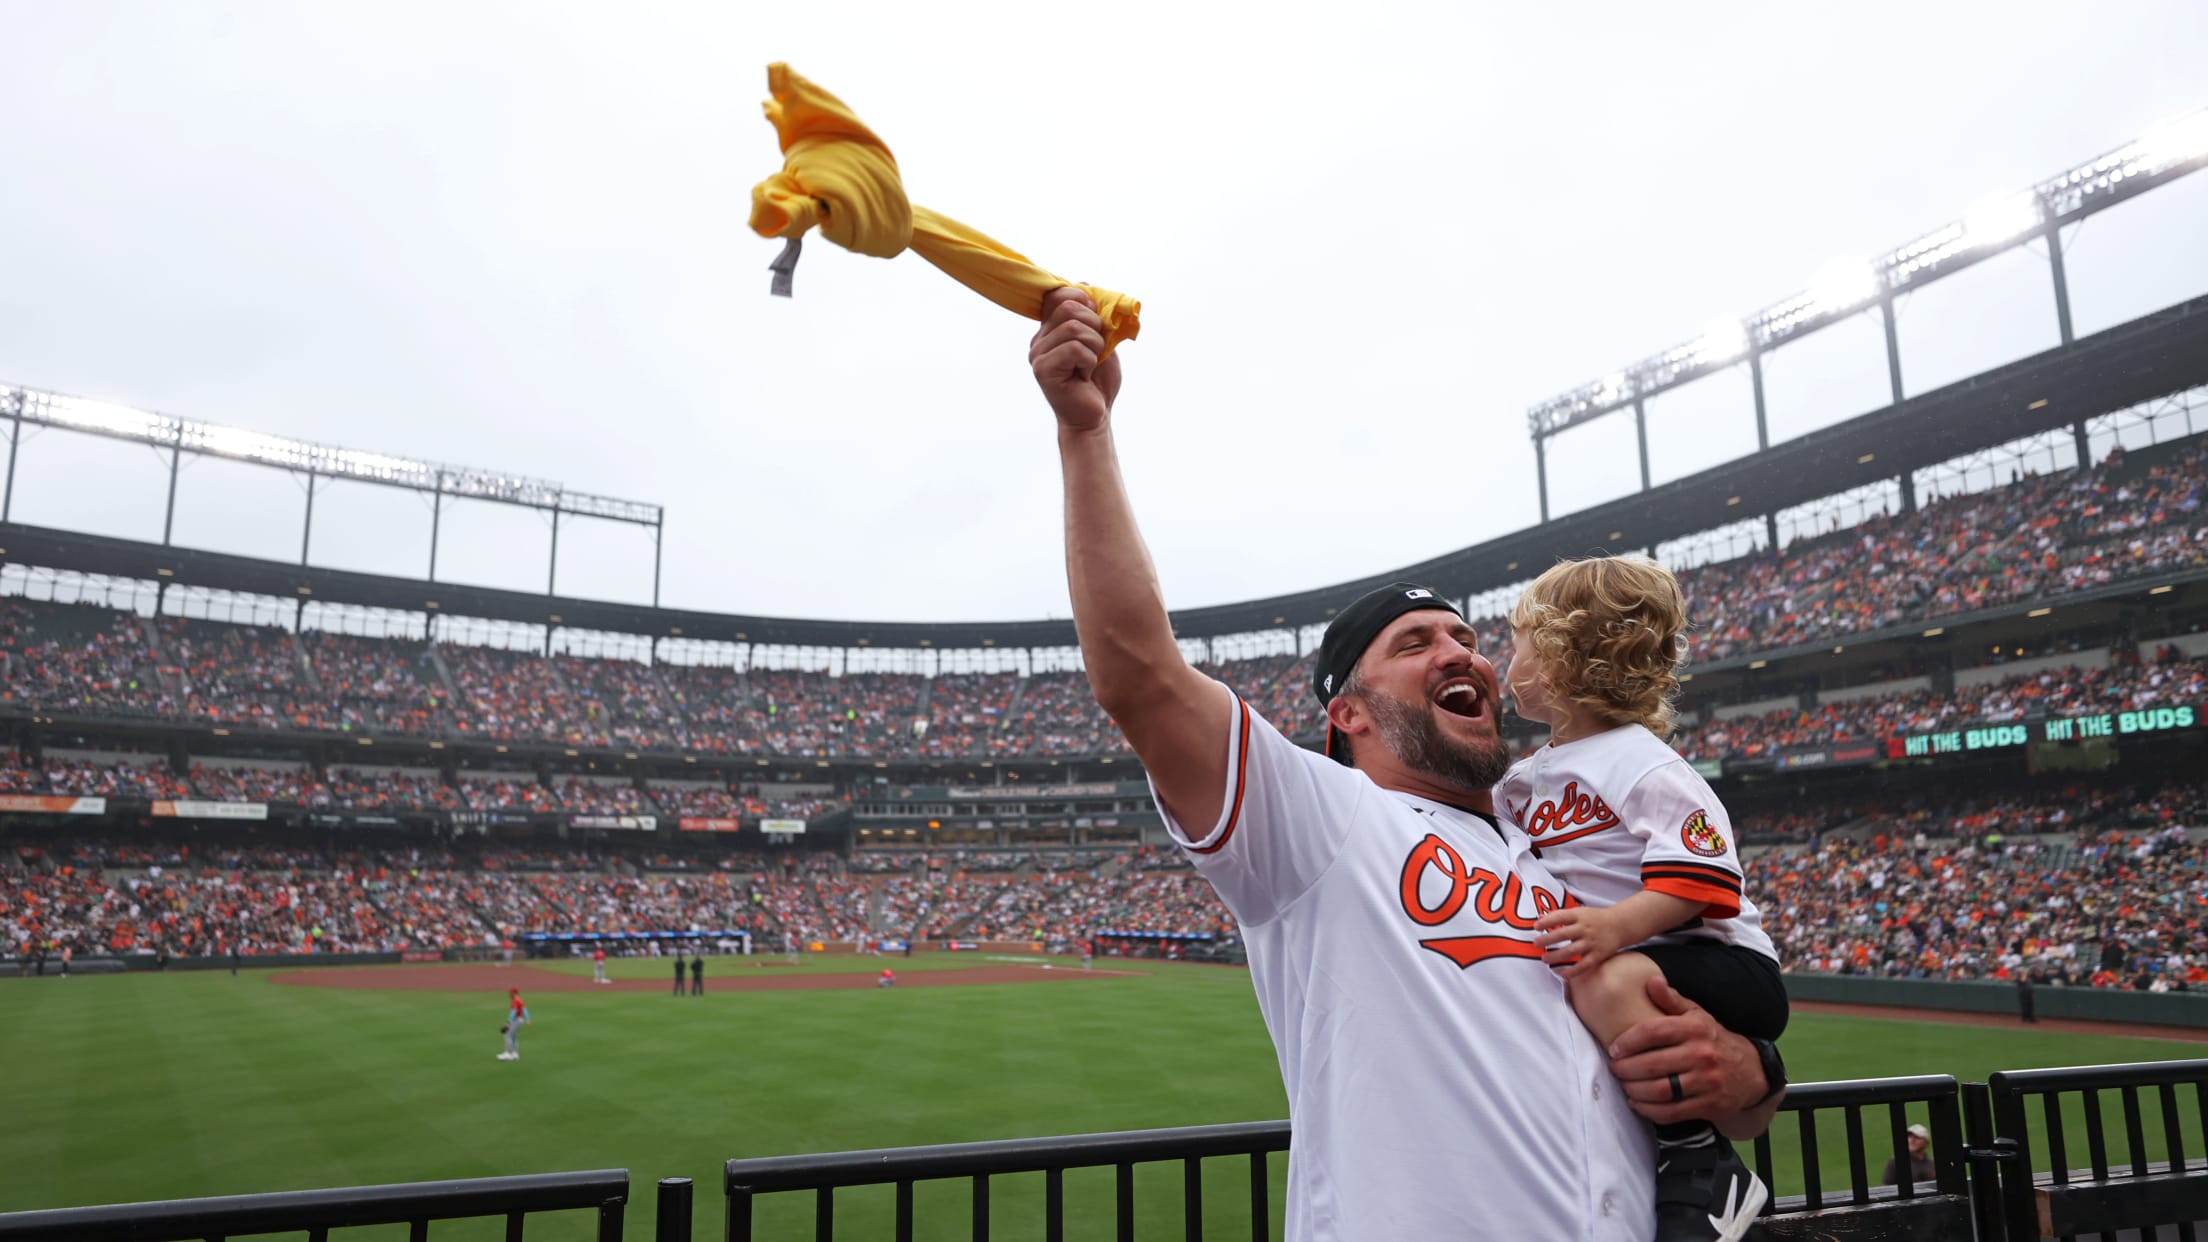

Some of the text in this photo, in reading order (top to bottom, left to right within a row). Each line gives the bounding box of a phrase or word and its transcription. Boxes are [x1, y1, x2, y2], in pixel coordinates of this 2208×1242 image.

[2045, 706, 2195, 741] HIT THE BUDS
[1905, 725, 2028, 756] HIT THE BUDS
